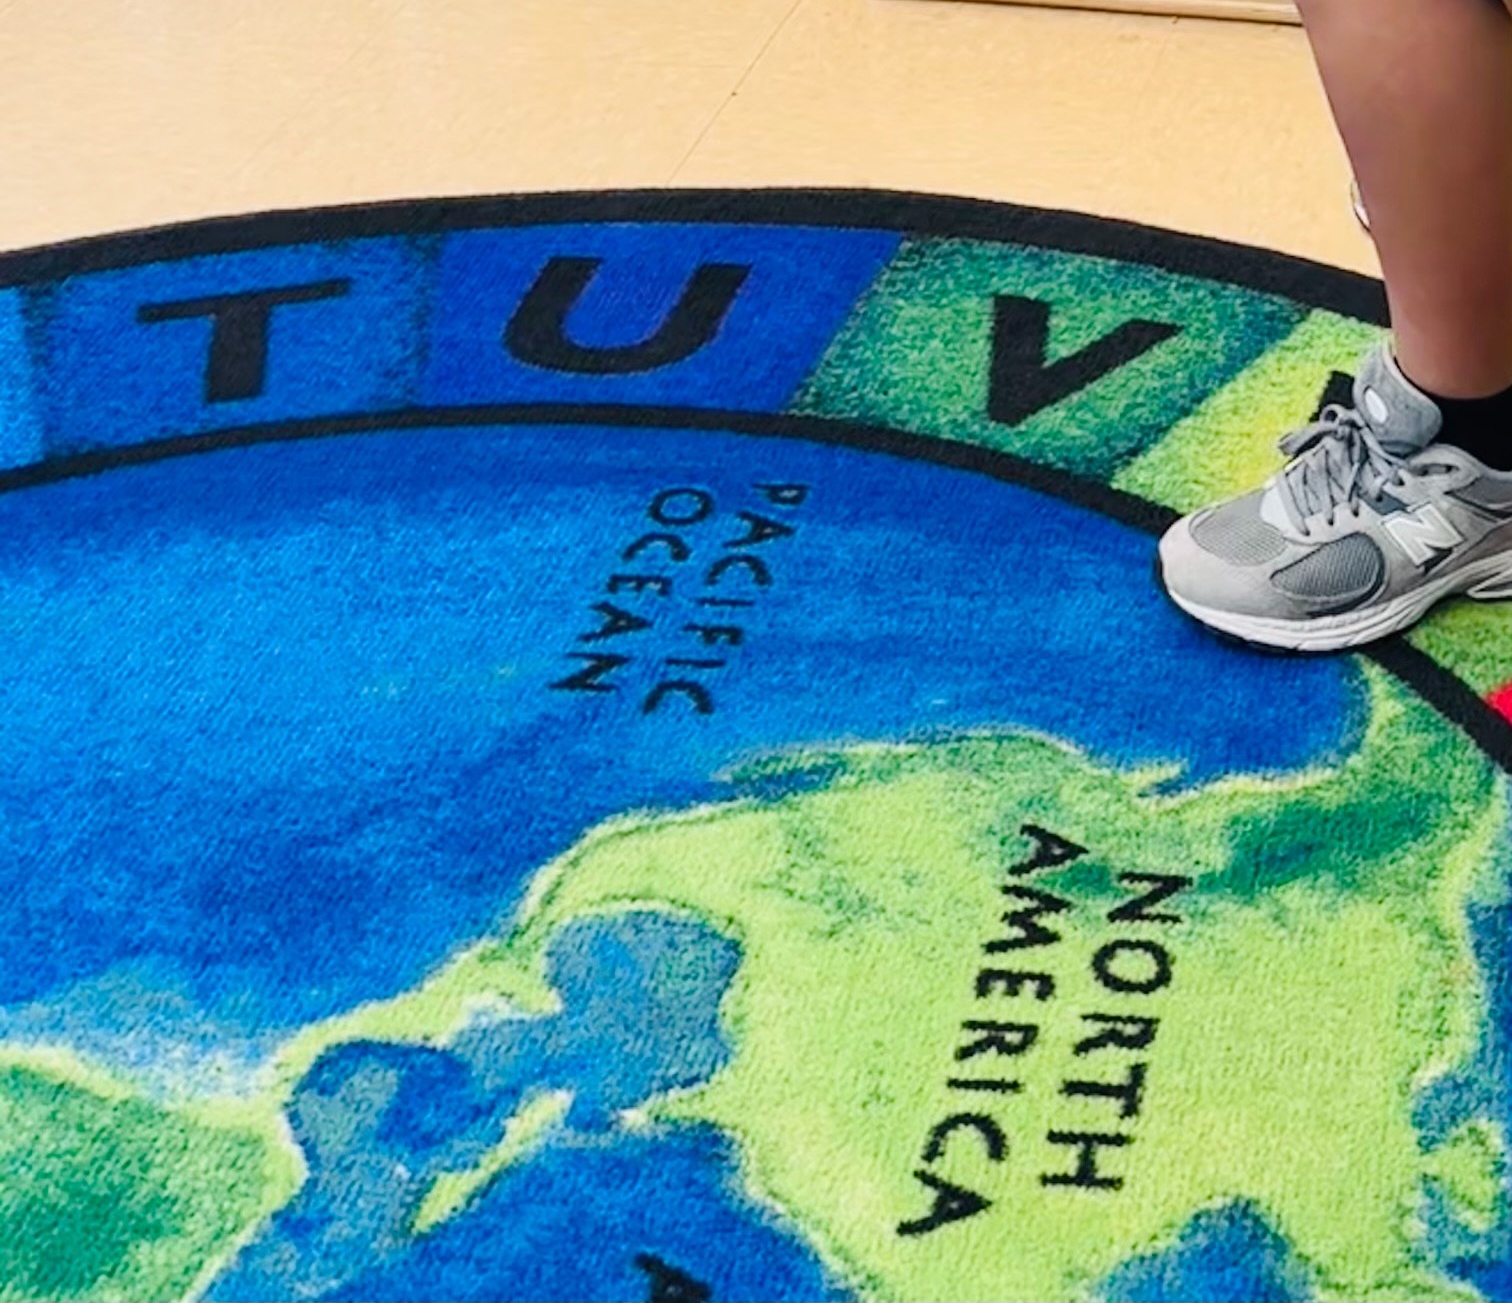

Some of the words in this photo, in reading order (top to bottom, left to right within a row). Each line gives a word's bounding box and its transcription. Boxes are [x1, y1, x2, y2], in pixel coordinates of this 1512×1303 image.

[135, 276, 353, 403] T
[502, 256, 755, 375] U
[986, 292, 1187, 427] V
[545, 487, 714, 694] OCEAN
[641, 483, 812, 715] PACIFIC
[896, 823, 1090, 1237] AMERICA
[1038, 870, 1195, 1191] NORTH
